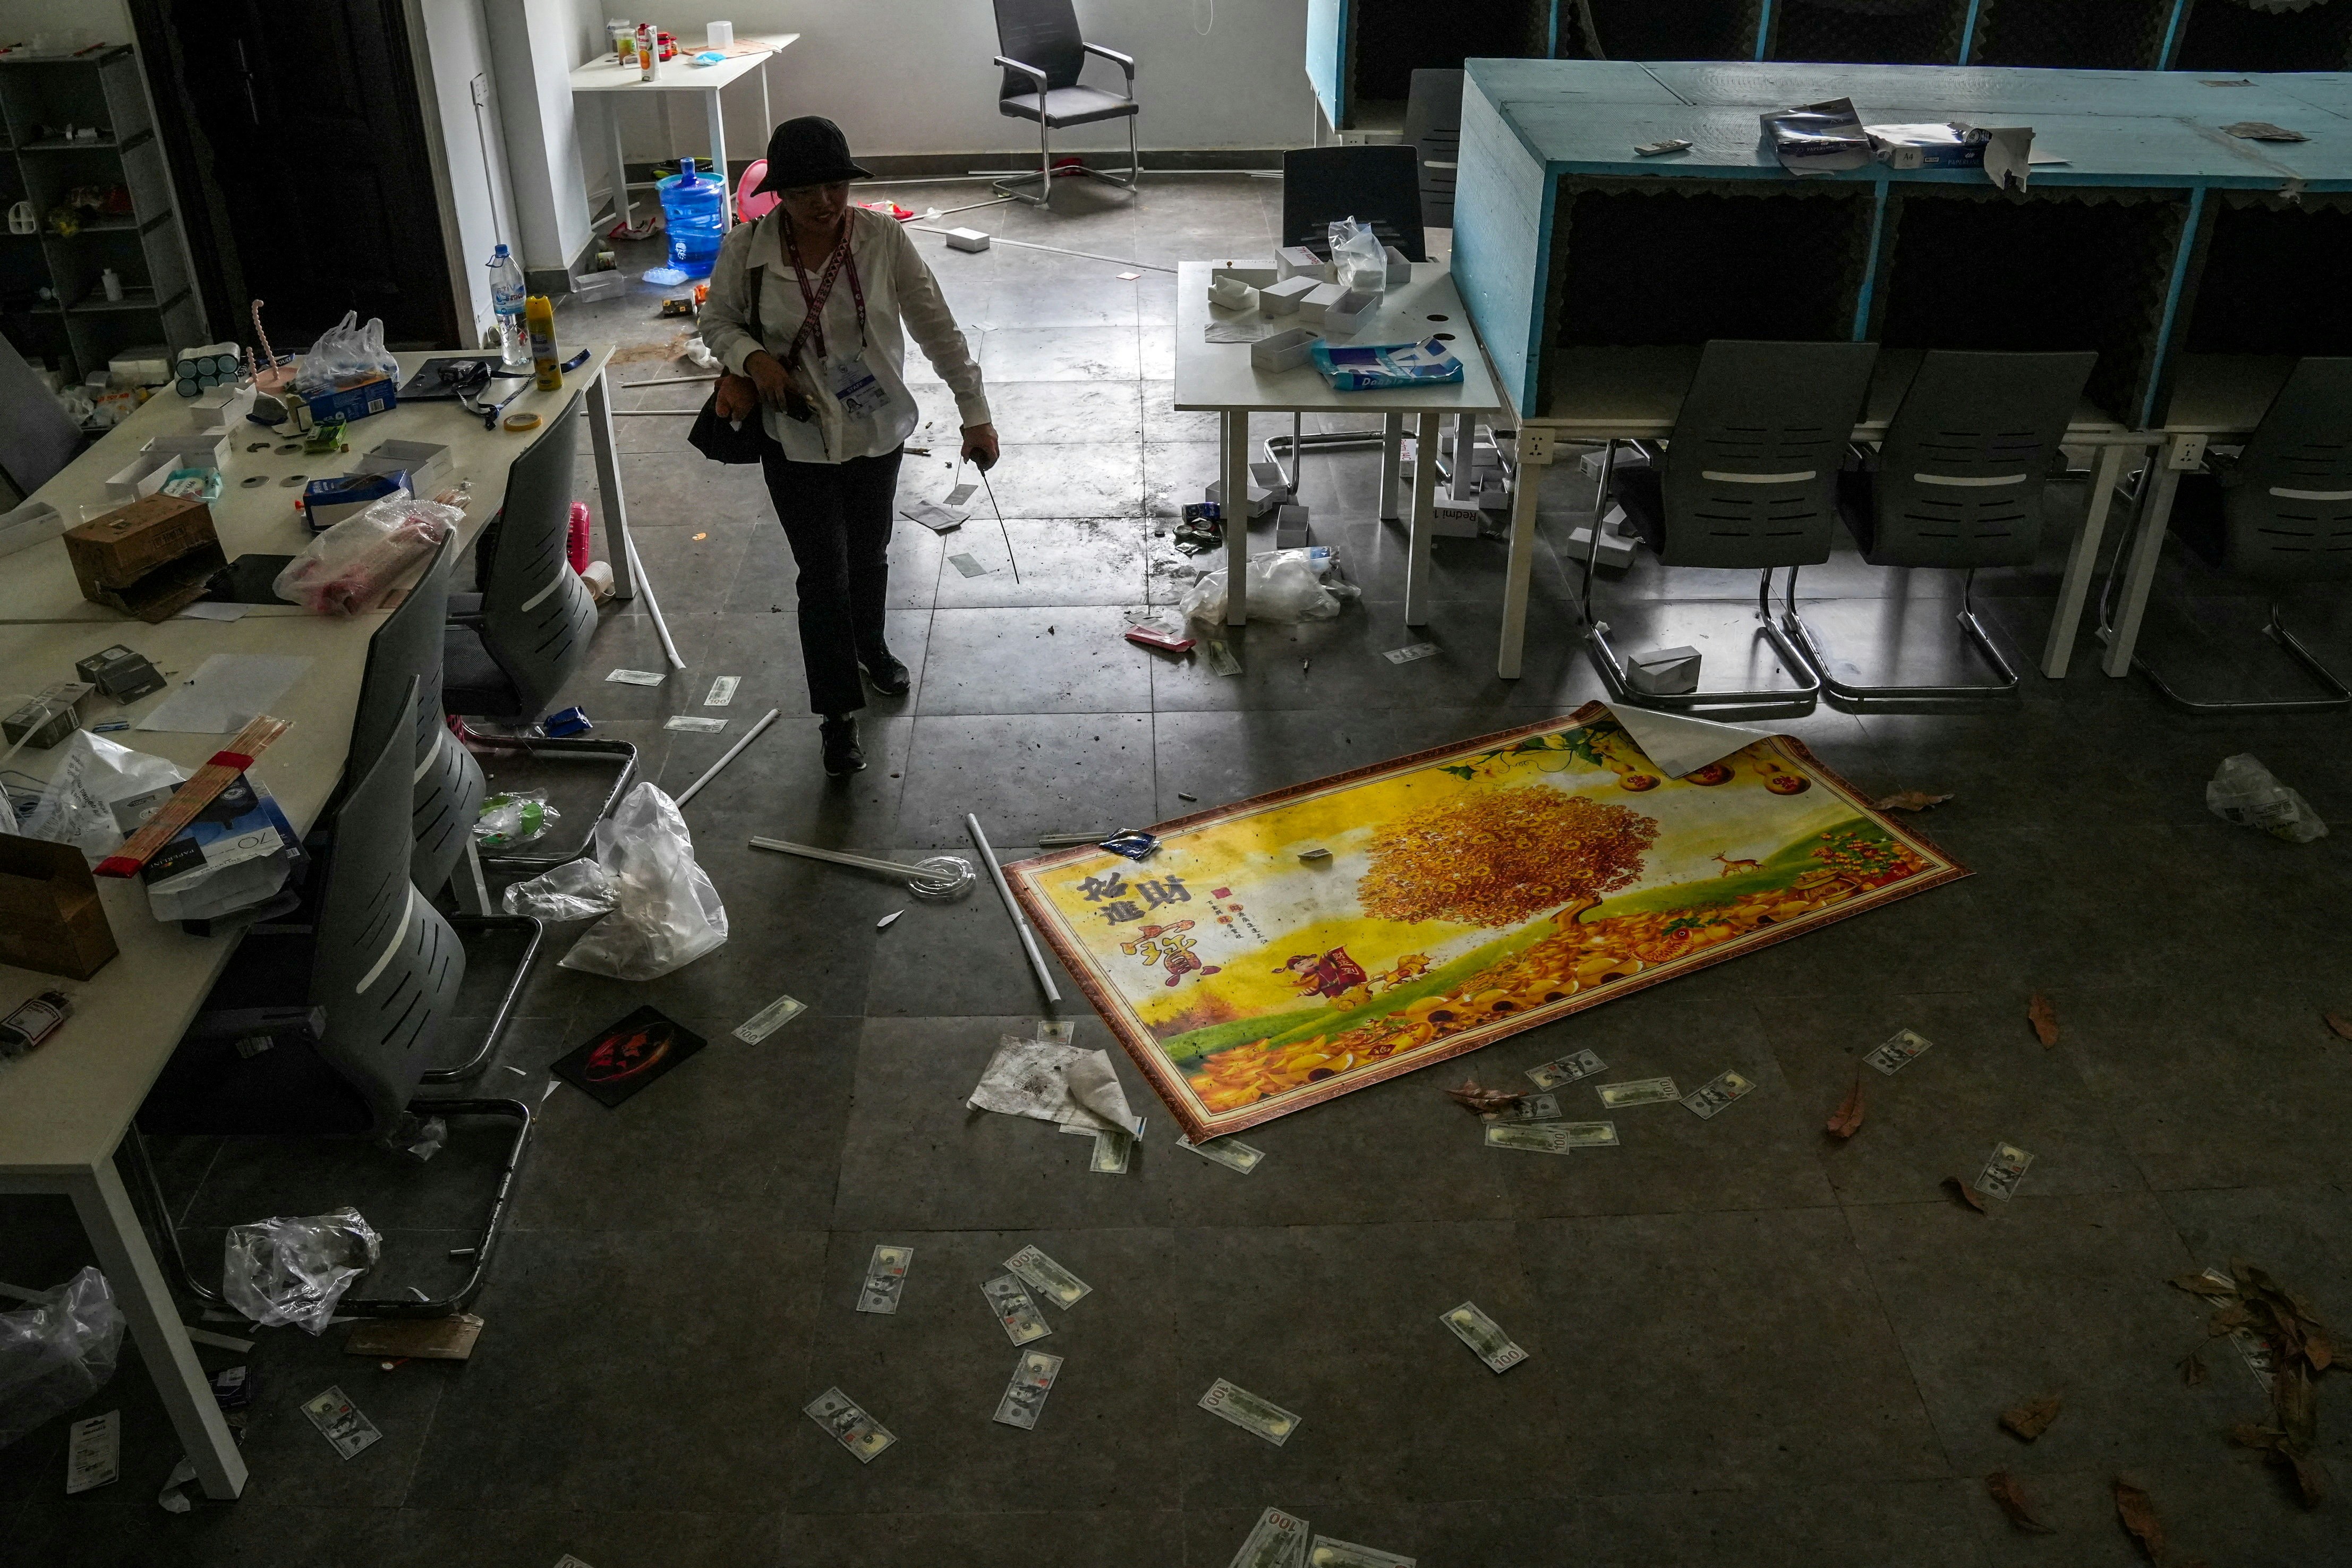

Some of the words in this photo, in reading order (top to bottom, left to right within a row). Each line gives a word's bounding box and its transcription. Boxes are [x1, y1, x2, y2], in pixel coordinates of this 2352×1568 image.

[1903, 152, 1914, 161] A4
[847, 382, 864, 393] STAFF
[1443, 510, 1477, 522] Redmi
[237, 832, 275, 850] 70
[148, 848, 195, 871] PAPERLINE
[739, 1028, 758, 1042] 100
[1660, 1080, 1675, 1097] 100
[1554, 1133, 1566, 1149] 100
[1011, 1250, 1033, 1268] 100
[1494, 1350, 1520, 1367] 100
[1205, 1385, 1230, 1406] 100
[1268, 1512, 1297, 1532] 100
